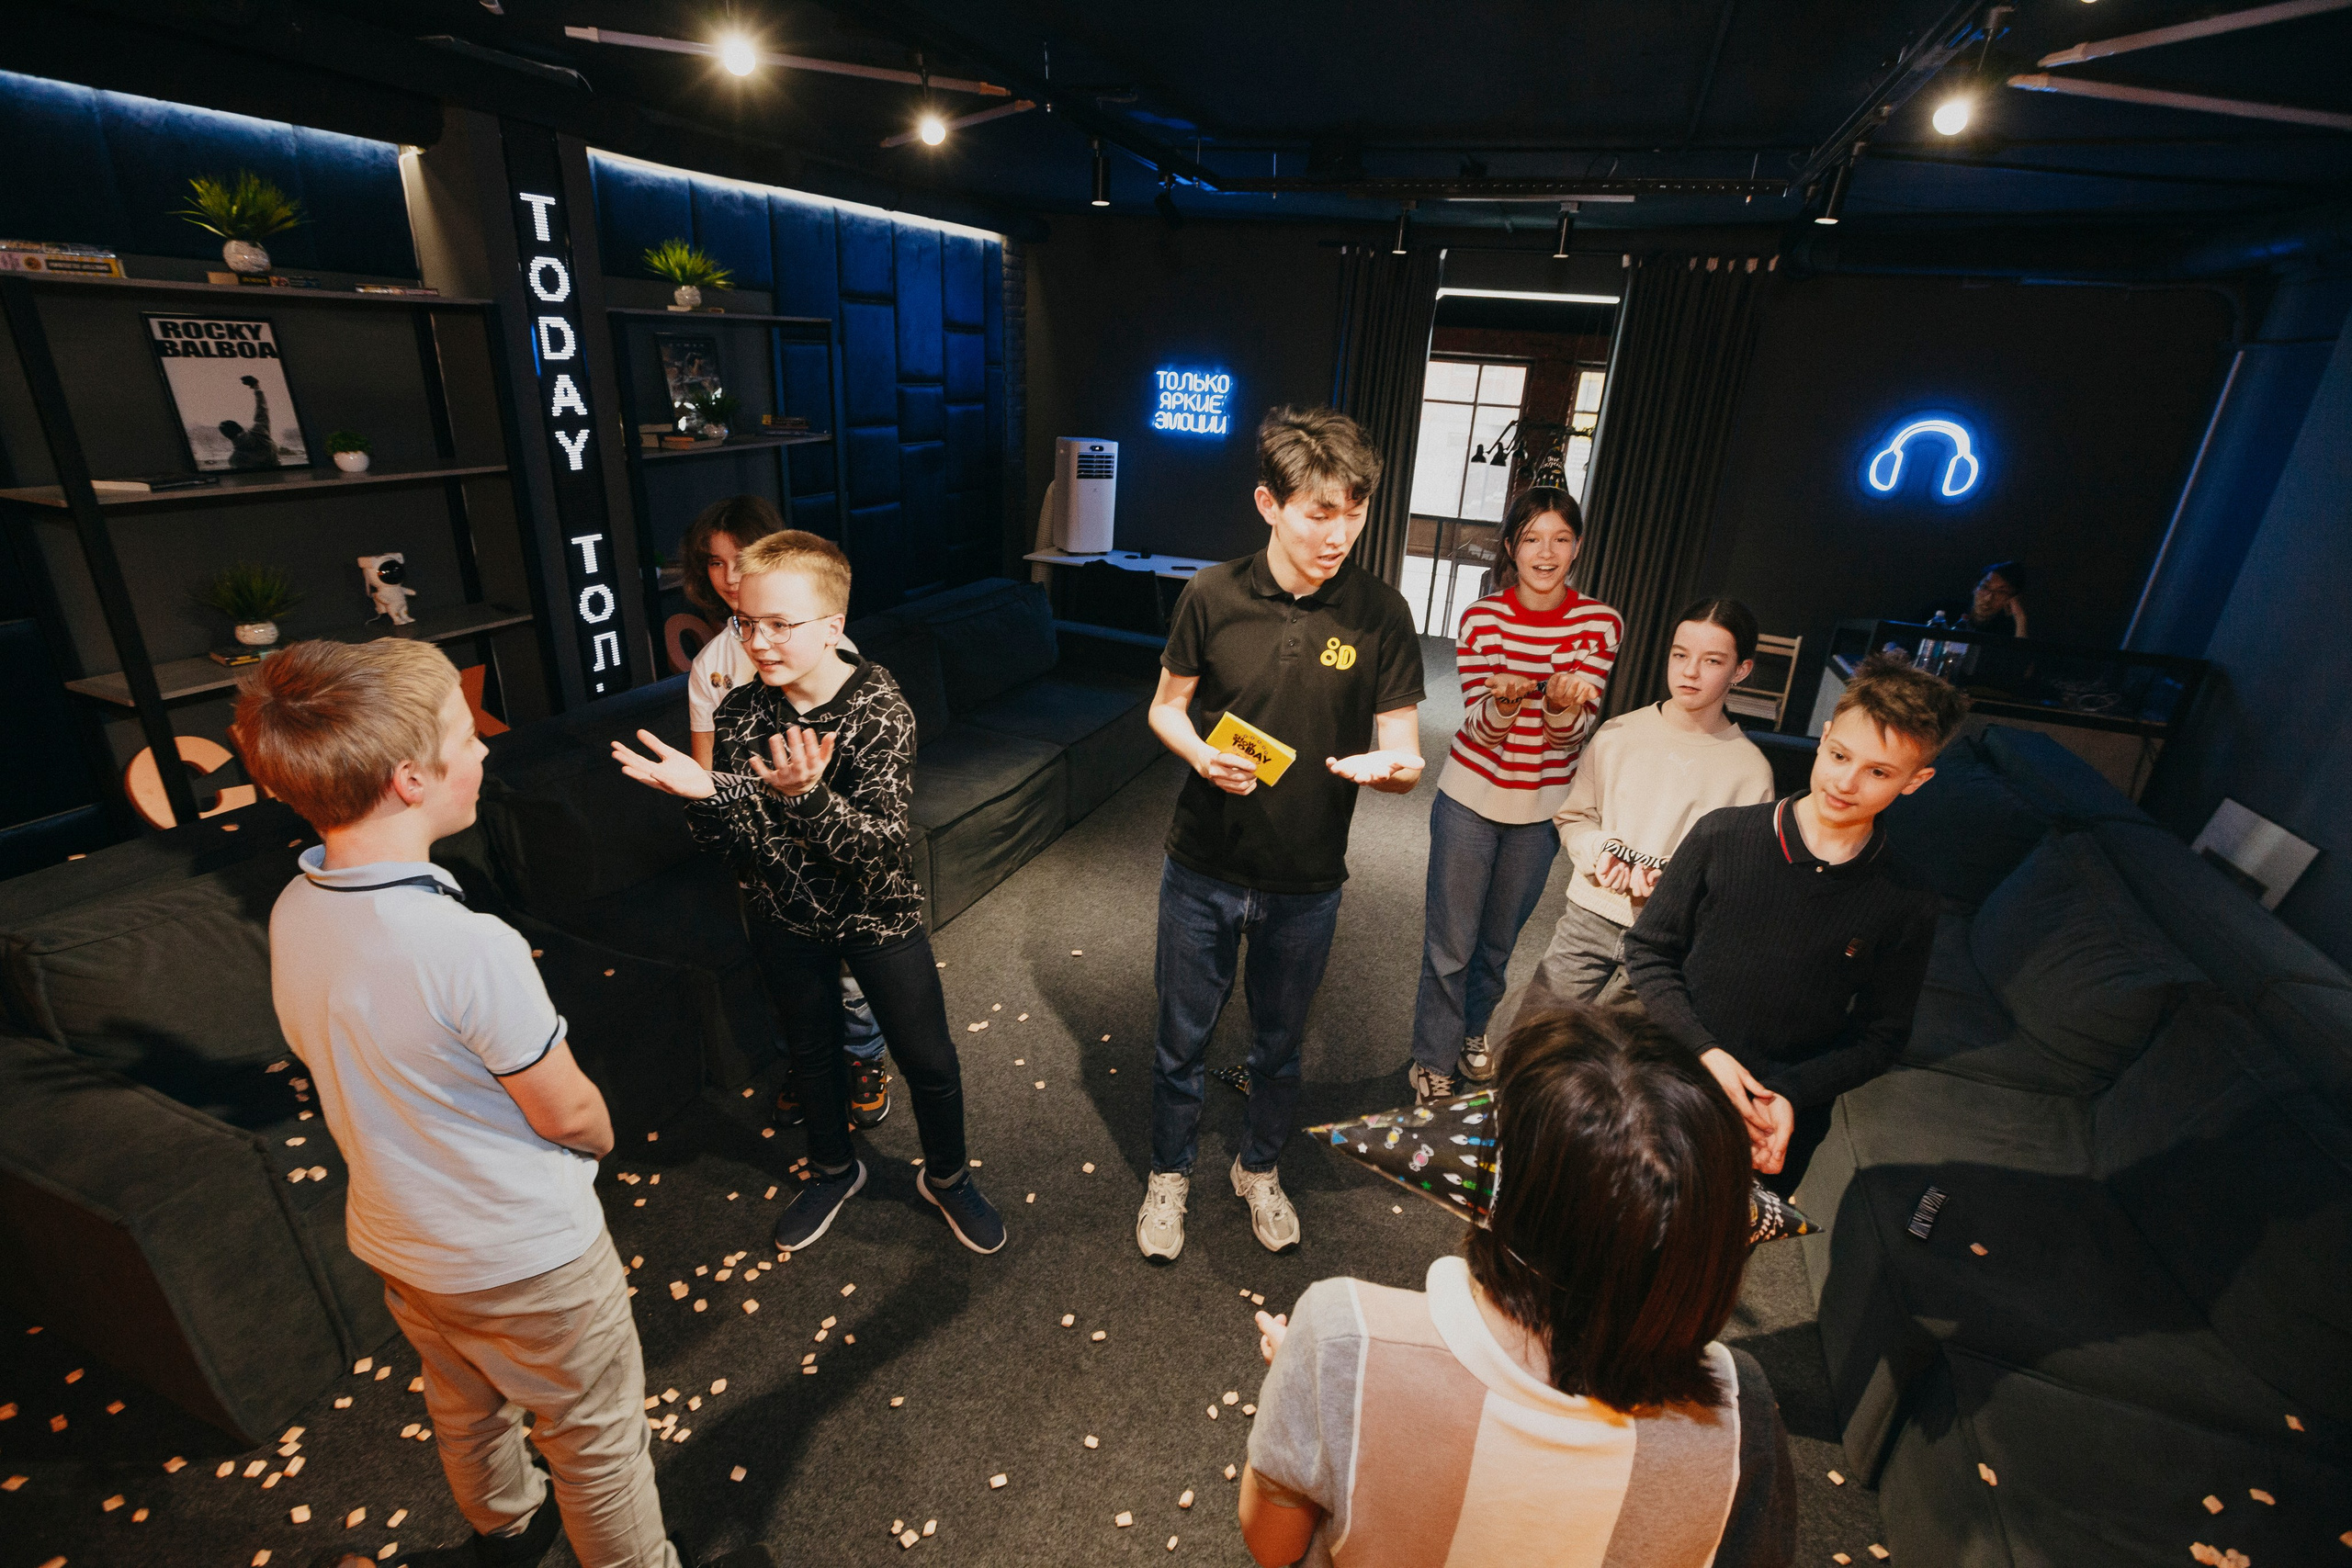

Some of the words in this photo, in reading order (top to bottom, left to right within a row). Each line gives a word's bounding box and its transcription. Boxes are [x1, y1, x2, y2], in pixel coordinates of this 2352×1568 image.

[157, 321, 263, 340] ROCKY
[519, 192, 590, 470] TODAY
[155, 339, 278, 358] BALBOA
[1156, 370, 1230, 394] ТОЛЬКО
[1159, 391, 1224, 414] ЯРКИЕ
[1154, 411, 1227, 434] ЭМОЦИИ
[1232, 739, 1272, 764] TODAY
[1233, 733, 1257, 750] SHOW
